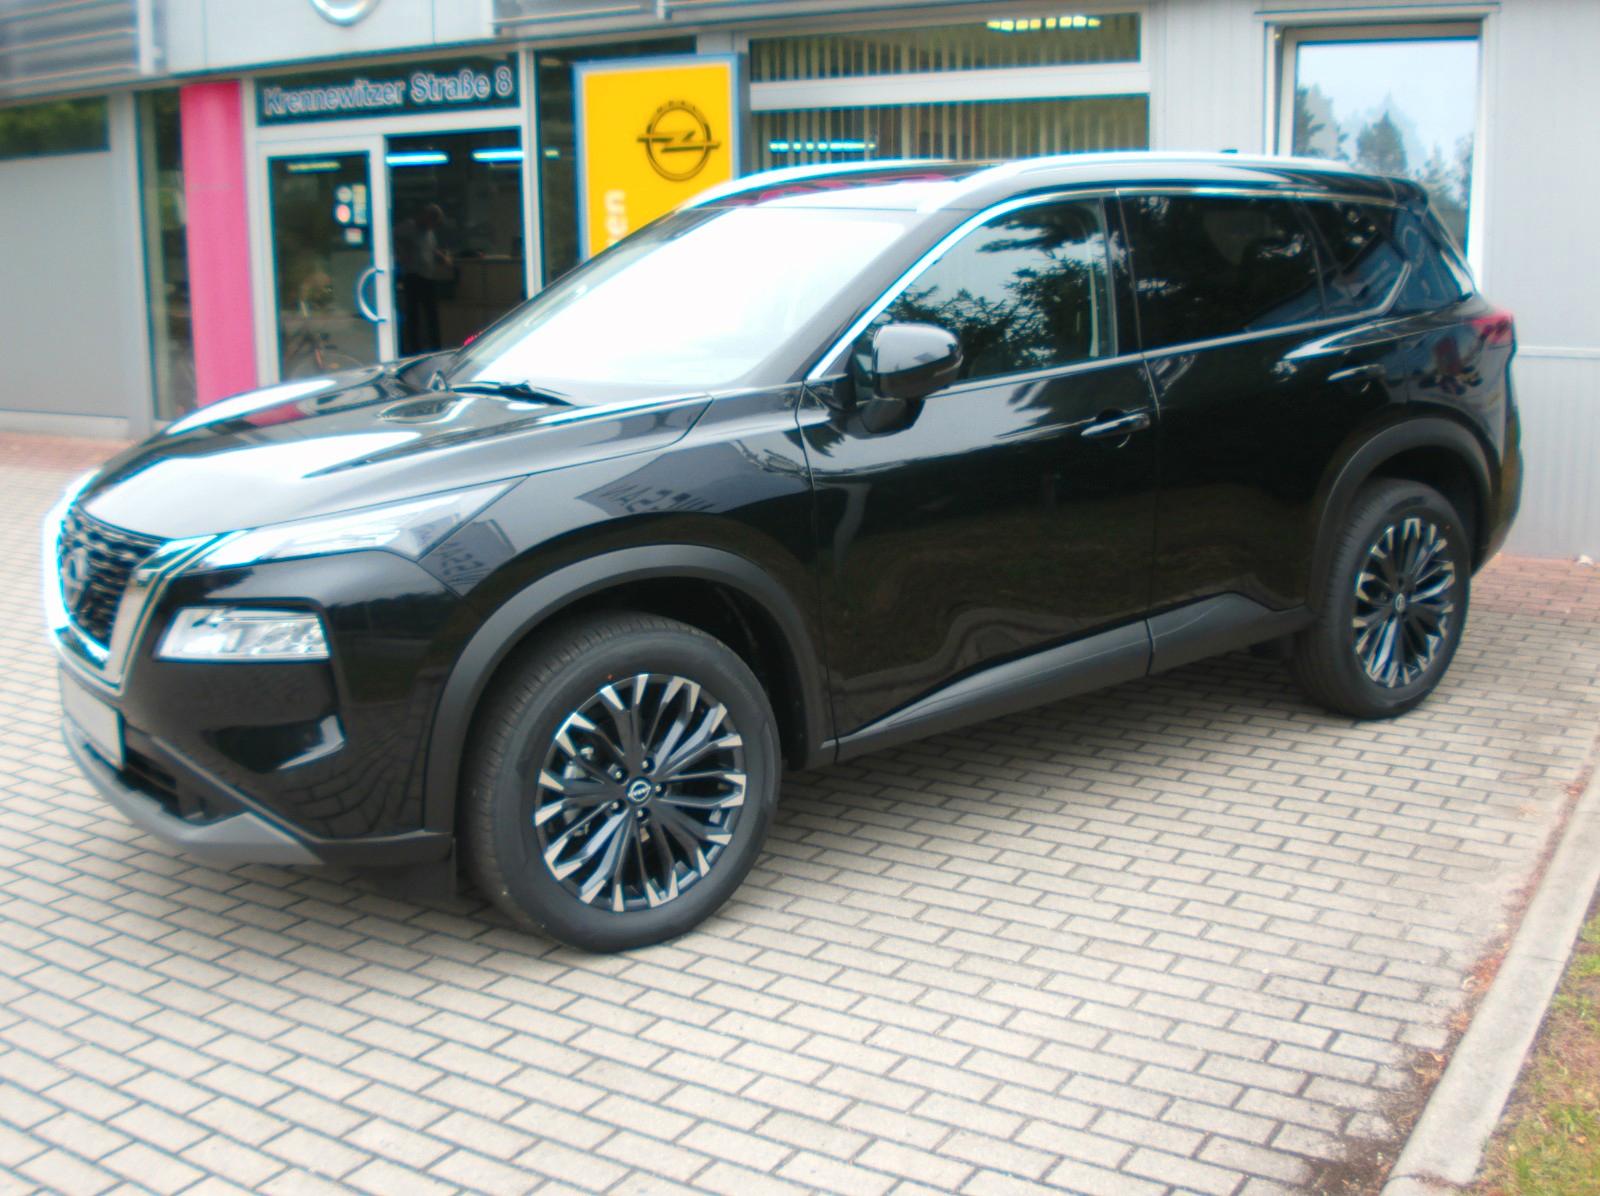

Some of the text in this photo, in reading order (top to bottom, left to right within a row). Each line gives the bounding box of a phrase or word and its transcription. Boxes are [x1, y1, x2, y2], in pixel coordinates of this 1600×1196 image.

[263, 65, 513, 116] Krennewitzer Straße 8
